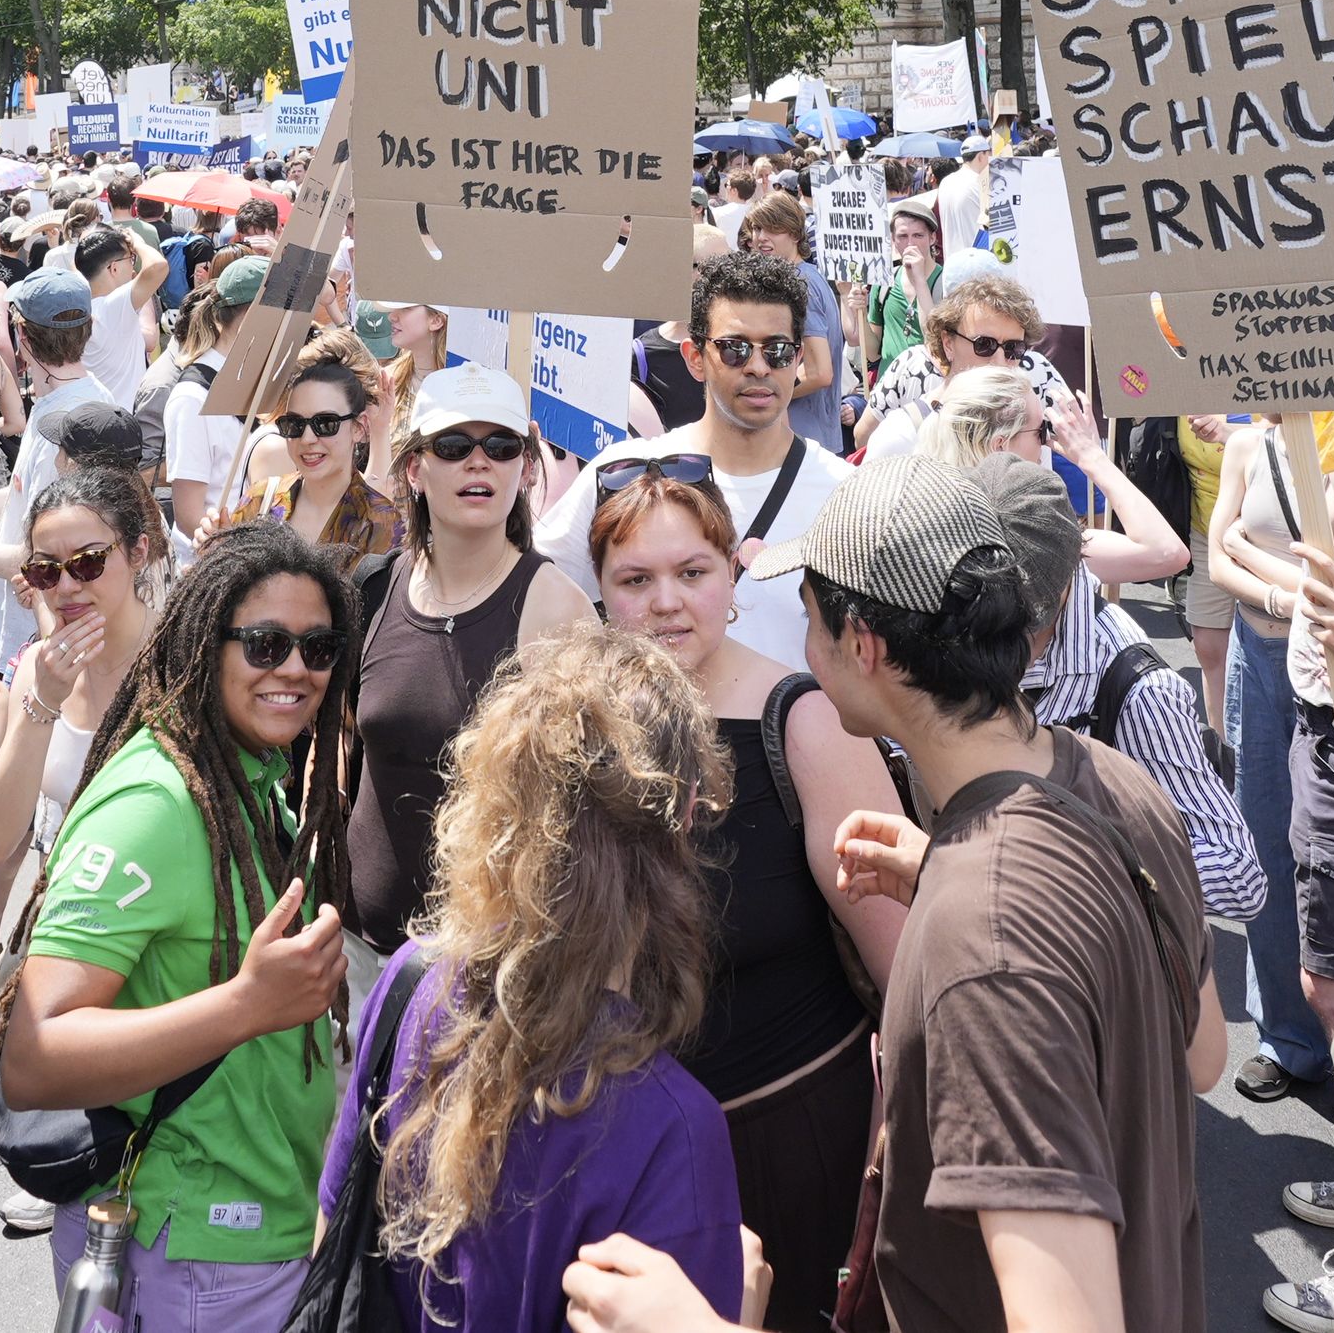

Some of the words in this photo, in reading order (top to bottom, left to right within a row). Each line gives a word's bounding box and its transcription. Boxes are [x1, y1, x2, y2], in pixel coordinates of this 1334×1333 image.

[304, 10, 337, 33] gibt
[341, 9, 350, 21] e
[434, 48, 549, 119] UNI
[149, 104, 211, 117] Kulturnation
[280, 106, 317, 116] WISSEN
[72, 114, 114, 126] BILDUNG
[147, 116, 162, 124] gibt
[174, 117, 193, 126] nicht
[277, 115, 320, 125] SCHAFFT
[78, 123, 110, 135] RECHNET
[147, 127, 208, 144] Nulltarif!
[275, 125, 321, 135] INNOVATION!
[71, 134, 89, 144] SICH
[90, 132, 117, 143] IMMER!
[211, 150, 224, 165] IST
[225, 146, 241, 163] DIE
[378, 130, 436, 169] DAS
[451, 138, 501, 171] IST
[511, 140, 582, 175] HIER
[596, 148, 664, 182] DIE
[831, 191, 867, 208] ZUGABE?
[829, 213, 844, 229] NUR
[824, 234, 852, 251] BUDGET
[854, 236, 883, 254] STIMMT
[535, 313, 588, 357] igenz
[1199, 351, 1248, 379] MAX
[533, 355, 563, 395] ibt.
[1123, 369, 1146, 393] Mut
[213, 1208, 228, 1220] 97
